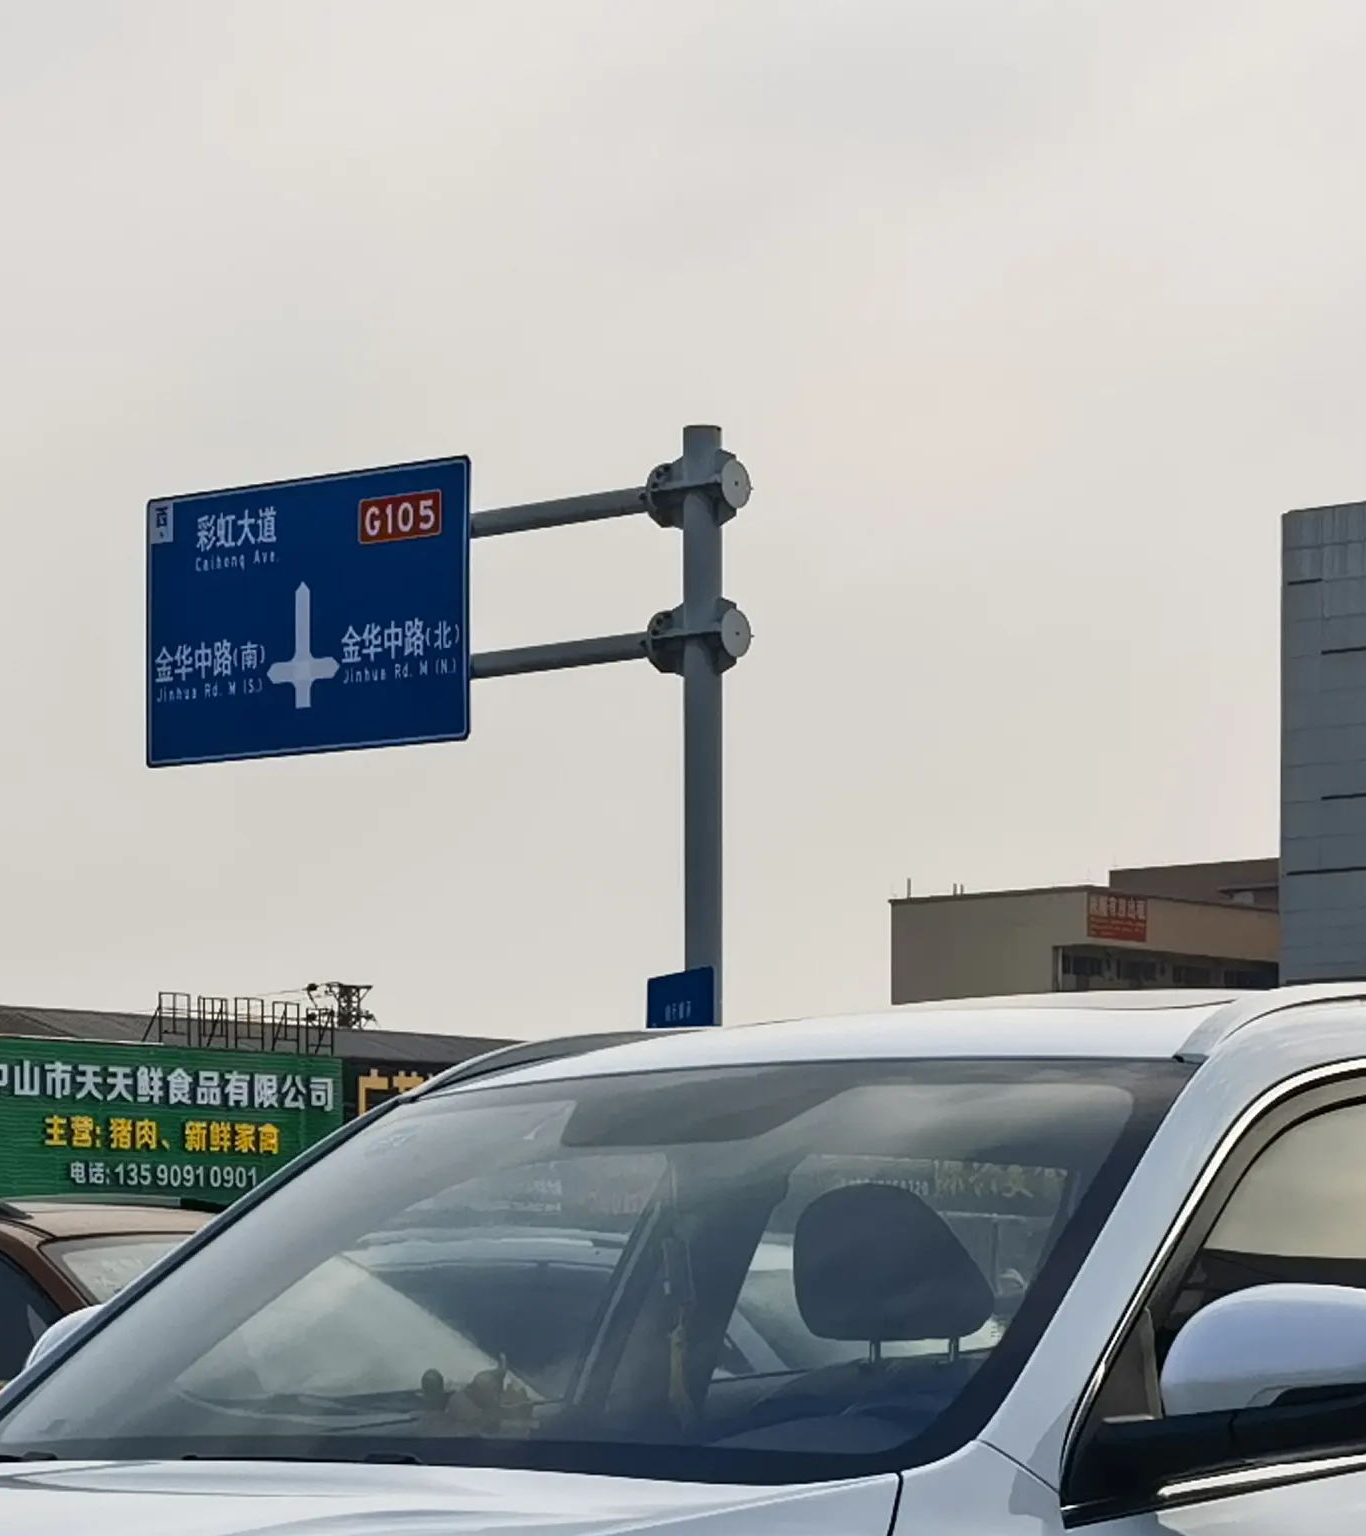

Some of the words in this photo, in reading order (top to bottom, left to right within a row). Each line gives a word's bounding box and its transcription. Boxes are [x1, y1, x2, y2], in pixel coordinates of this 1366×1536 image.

[196, 506, 277, 552] 彩虹大道
[365, 499, 435, 536] G105
[195, 553, 245, 571] Caihong
[341, 617, 460, 663] 金华中路(北)
[154, 638, 265, 682] 金华中路(南)
[343, 667, 386, 684] Jinhua
[395, 661, 413, 679] Rd.
[156, 686, 197, 703] Jinhua
[204, 682, 222, 698] Rd.
